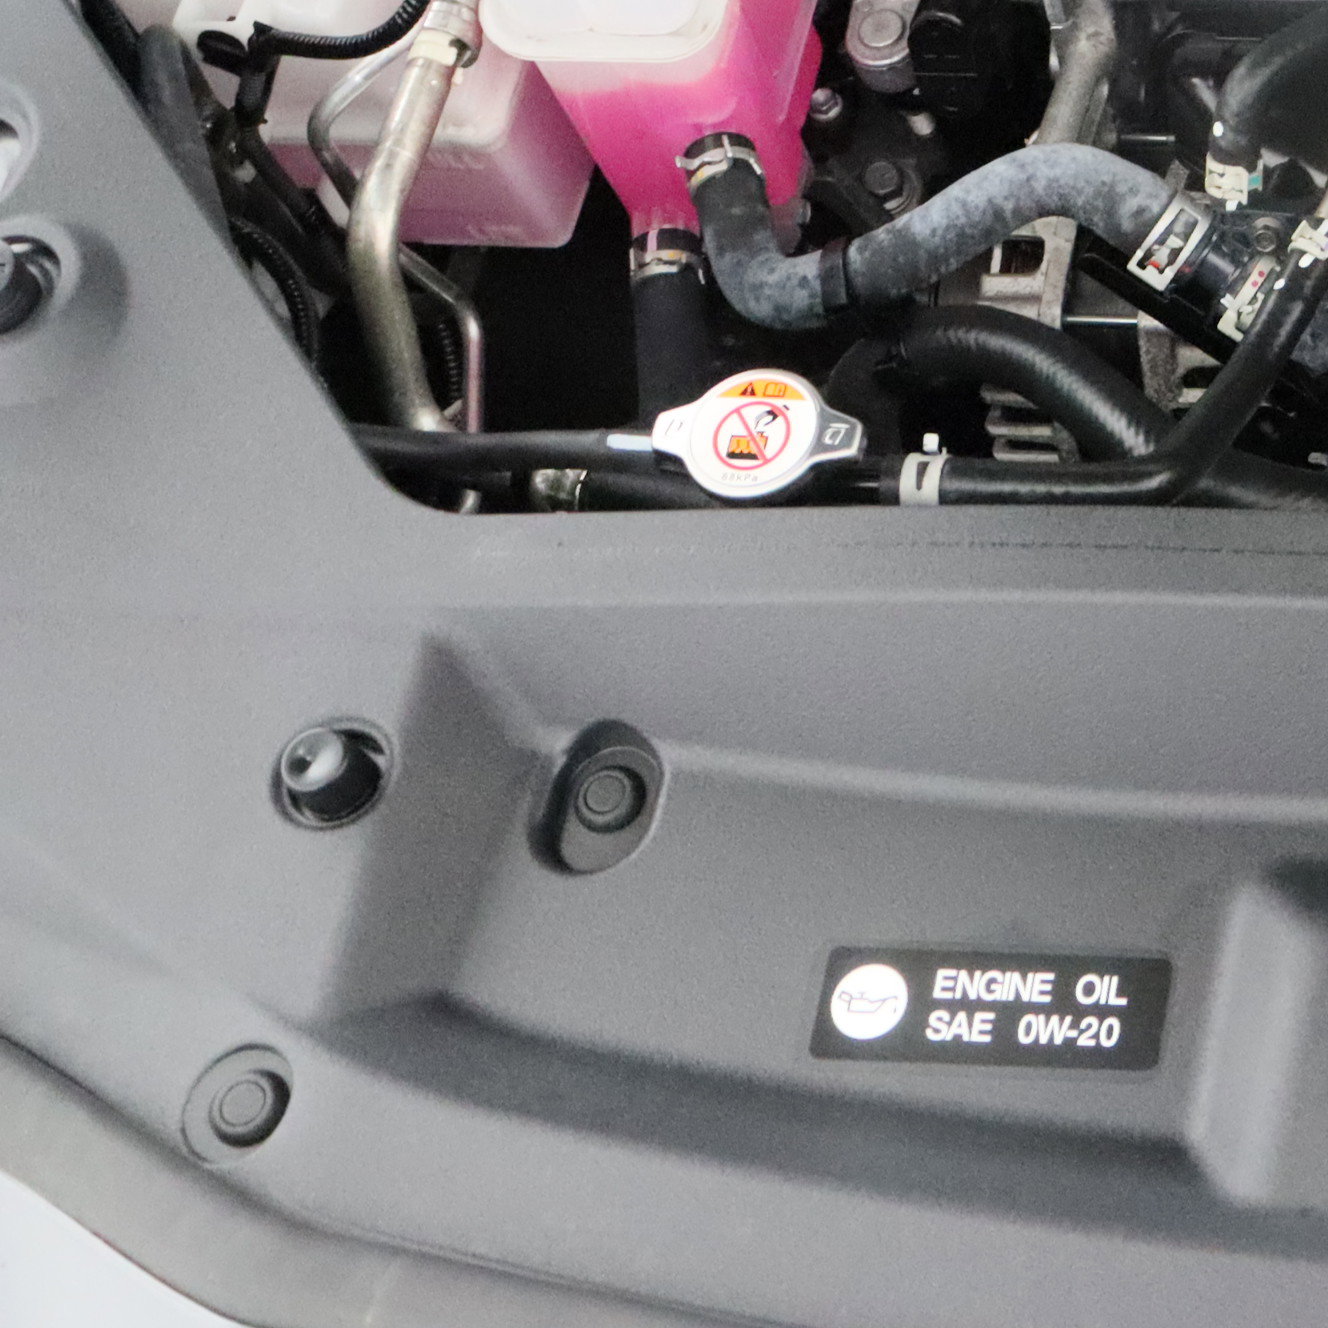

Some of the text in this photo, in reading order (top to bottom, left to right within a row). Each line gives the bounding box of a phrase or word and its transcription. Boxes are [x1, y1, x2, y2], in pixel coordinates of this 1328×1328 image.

[932, 968, 1129, 1006] ENGINE OIL
[925, 1010, 1121, 1048] SAE 0W-20
